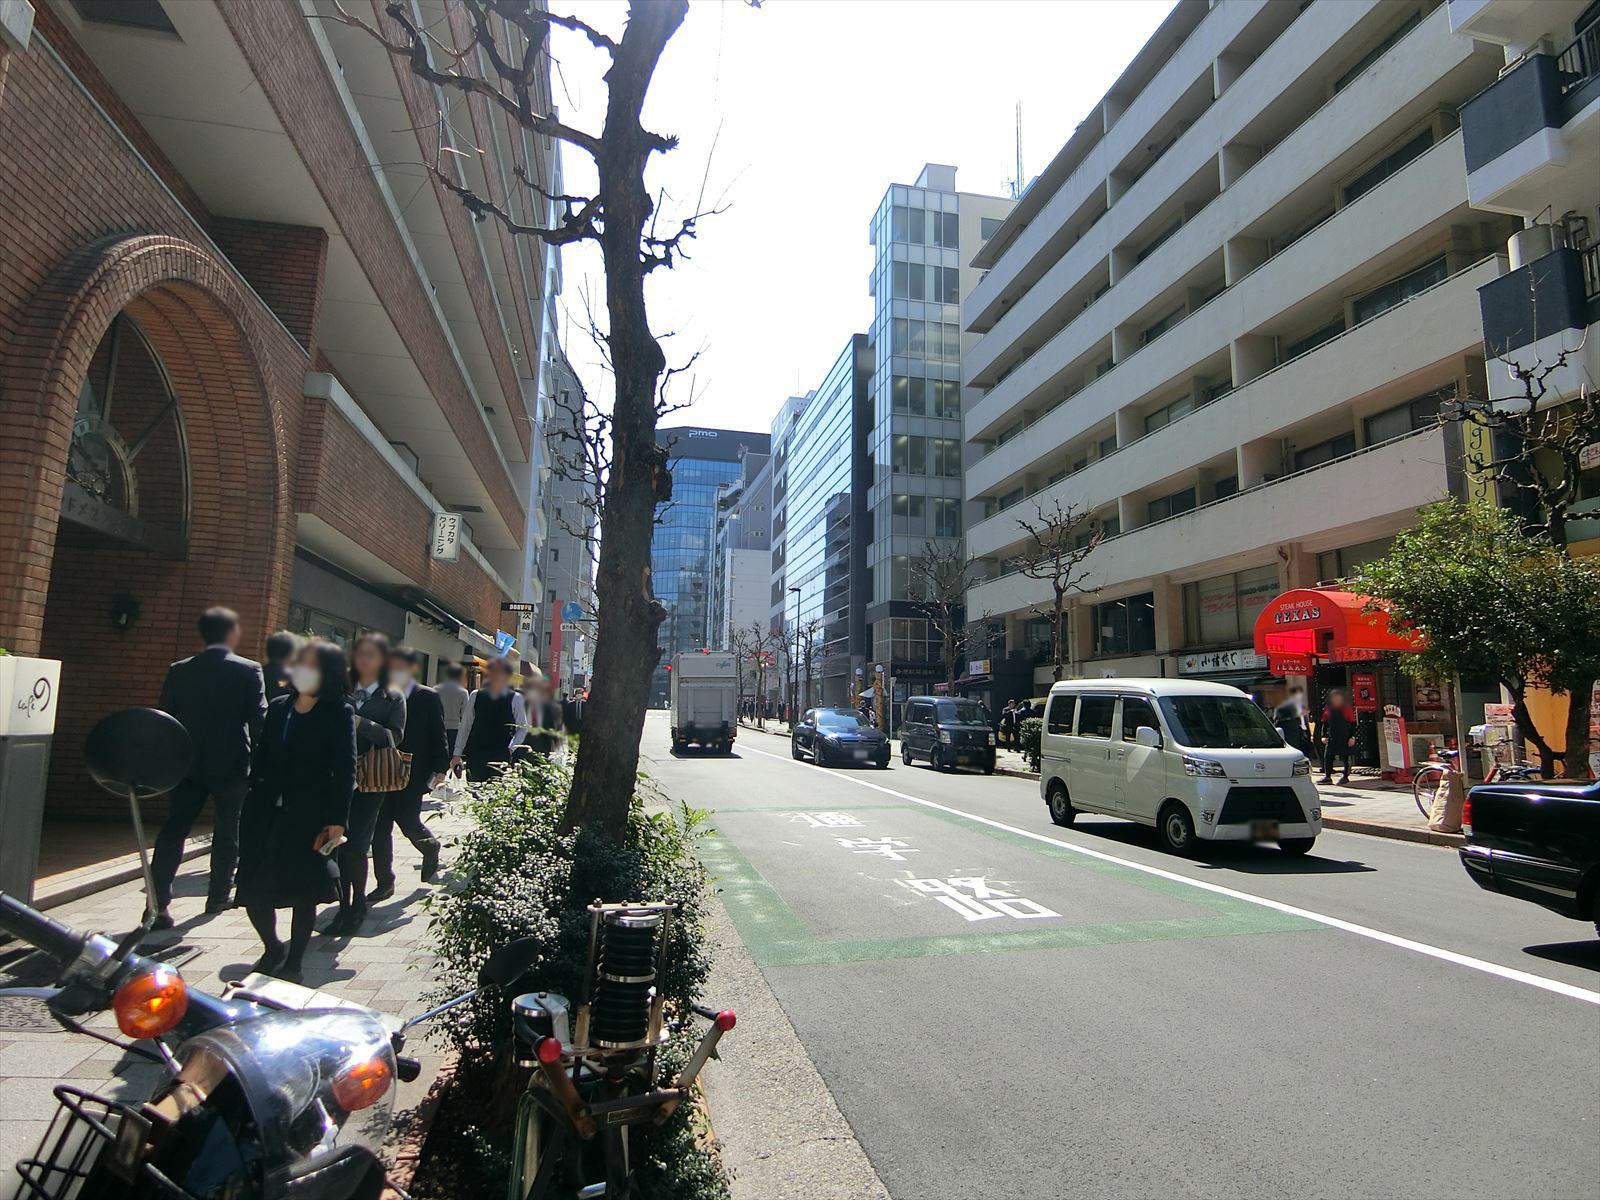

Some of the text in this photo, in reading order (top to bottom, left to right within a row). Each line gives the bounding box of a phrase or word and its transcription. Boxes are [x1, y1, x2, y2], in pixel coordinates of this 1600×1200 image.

[1280, 599, 1313, 611] STEAK HOUSE
[1274, 607, 1321, 624] TEXAS
[1276, 663, 1308, 672] TEXAS
[33, 677, 51, 712] 9
